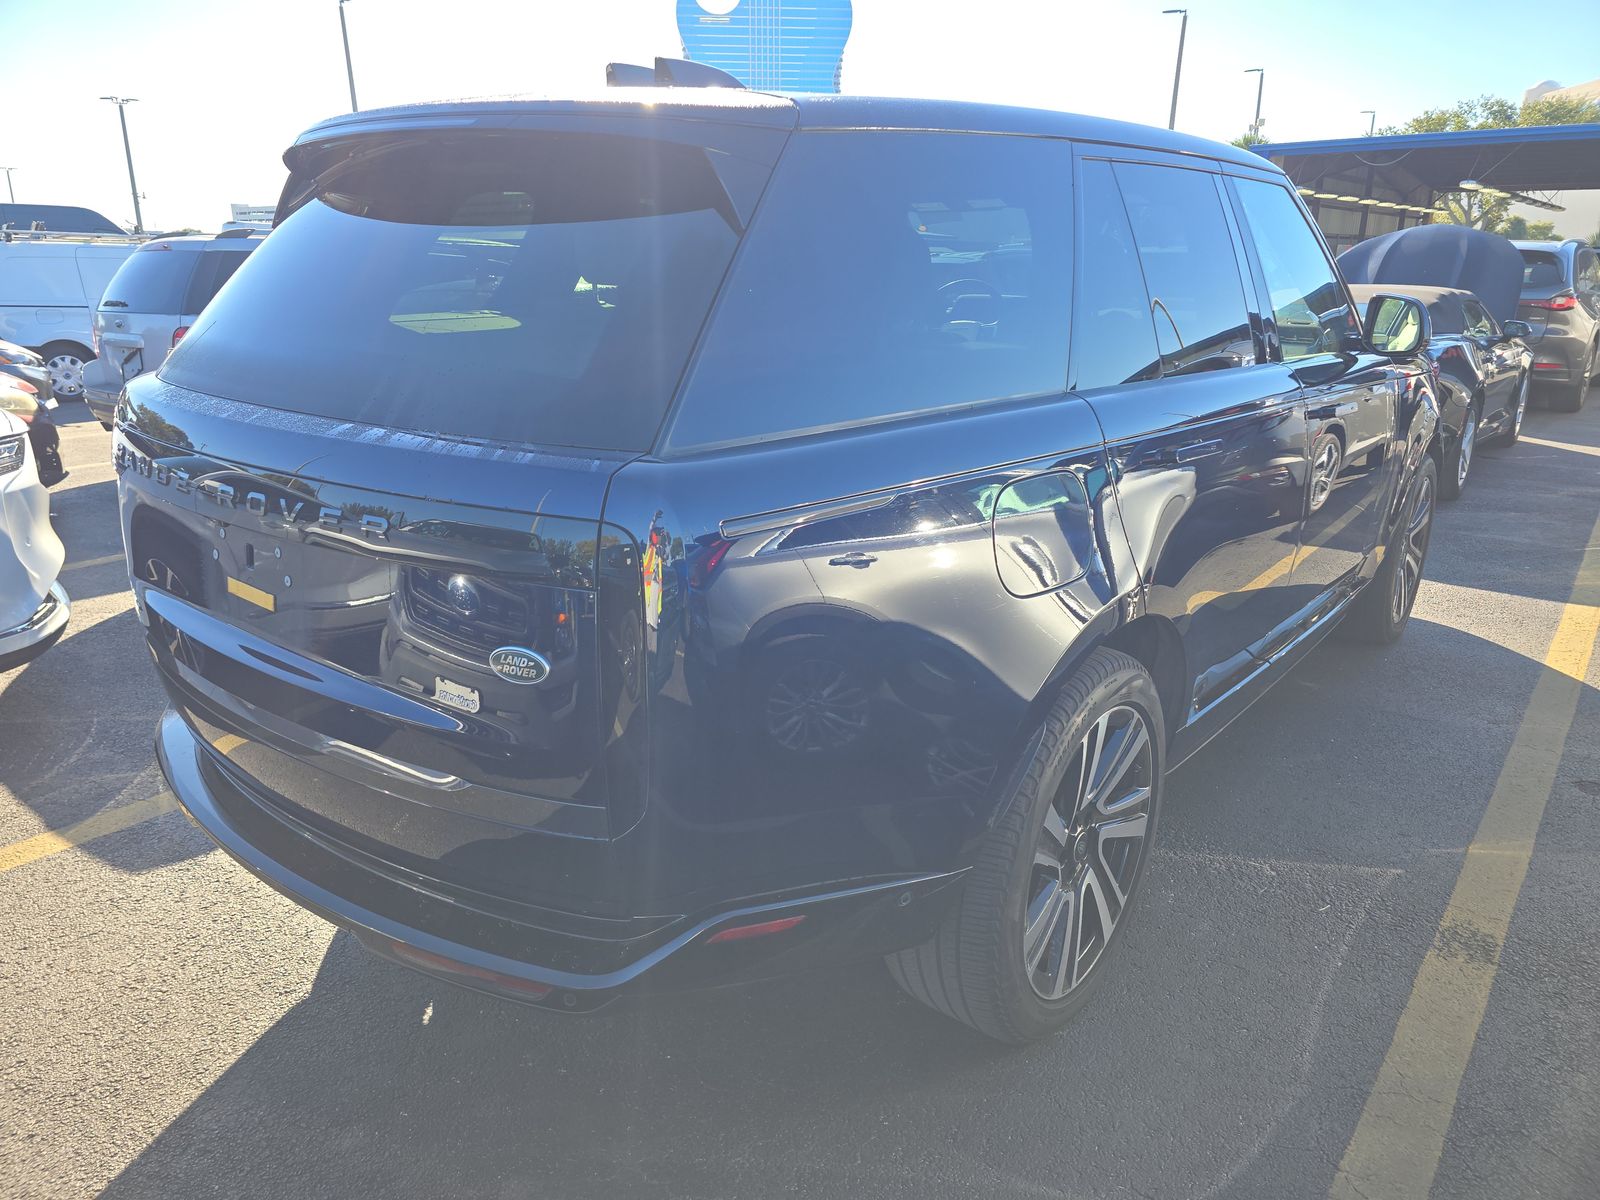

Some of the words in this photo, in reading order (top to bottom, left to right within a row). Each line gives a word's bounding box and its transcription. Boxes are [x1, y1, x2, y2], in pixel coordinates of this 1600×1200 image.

[216, 483, 391, 540] ROVER
[500, 654, 529, 667] LAND
[503, 665, 536, 678] ROVER
